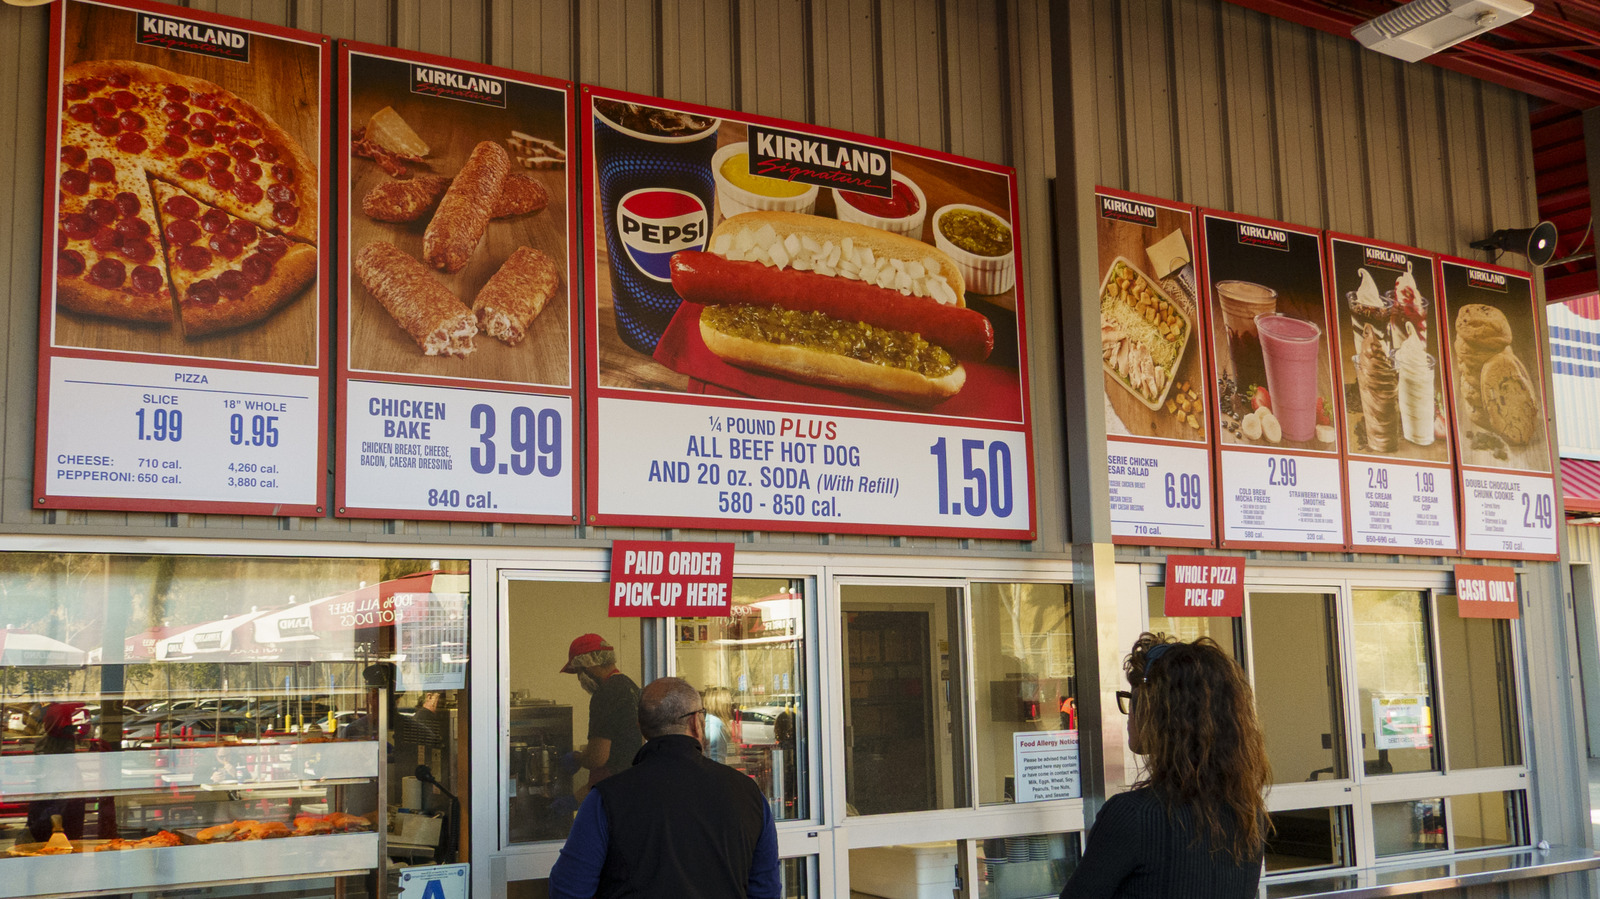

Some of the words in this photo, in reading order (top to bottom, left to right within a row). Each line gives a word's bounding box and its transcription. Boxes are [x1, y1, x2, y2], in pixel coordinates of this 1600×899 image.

[144, 17, 245, 48] KIRKLAND
[143, 34, 244, 57] Signature
[417, 68, 502, 95] KIRKLAND
[416, 83, 502, 103] Signature
[757, 132, 886, 176] KIRKLAND
[757, 159, 887, 189] Signature
[1104, 198, 1155, 218] KIRKLAND
[623, 214, 704, 244] PEPSI
[1240, 225, 1286, 242] KIRKLAND
[1366, 248, 1406, 264] KIRKLAND
[1469, 270, 1505, 285] KIRKLAND
[174, 373, 209, 384] PIZZA
[143, 394, 178, 405] SLICE
[245, 401, 287, 412] WHOLE
[369, 398, 445, 420] CHICKEN
[136, 408, 183, 442] 1.99
[230, 414, 279, 447] 9.95
[384, 420, 431, 440] BAKE
[727, 417, 775, 435] POUND
[780, 418, 837, 440] PLUS
[362, 442, 393, 454] CHICKEN
[395, 443, 423, 457] BREAST,
[424, 445, 451, 459] CHEESE,
[470, 404, 562, 477] 3.99
[687, 436, 722, 458] ALL
[730, 438, 774, 460] BEEF
[781, 442, 817, 464] HOT
[824, 445, 860, 467] DOG
[58, 455, 114, 466] CHEESE:
[138, 458, 158, 469] 710
[162, 458, 182, 469] cal.
[228, 463, 257, 474] 4,260
[260, 464, 279, 474] cal.
[361, 455, 387, 468] BACON,
[390, 457, 417, 468] CAESAR
[419, 458, 453, 470] DRESSING
[1128, 467, 1149, 476] SALAD
[1130, 457, 1158, 467] CHICKEN
[1268, 457, 1297, 486] 2.99
[57, 470, 135, 482] PEPPERONI:
[138, 473, 158, 483] 650
[162, 473, 182, 484] cal.
[228, 478, 257, 488] 3,880
[260, 479, 278, 488] cal.
[648, 461, 690, 483] AND
[698, 463, 720, 485] 20
[727, 469, 752, 486] oz.
[760, 466, 810, 490] SODA
[817, 474, 853, 494] (With
[858, 476, 899, 497] Refill)
[930, 436, 1013, 518] 1.50
[1368, 468, 1388, 489] 2.49
[1415, 472, 1434, 492] 1.99
[1465, 479, 1488, 488] DOUBLE
[1489, 481, 1520, 491] CHOCOLATE
[428, 489, 460, 507] 840
[466, 492, 498, 509] cal.
[1165, 472, 1201, 510] 6.99
[1422, 496, 1438, 504] CREAM
[1474, 489, 1493, 499] CHUNK
[1494, 491, 1514, 500] COOKIE
[718, 492, 752, 513] 580
[773, 494, 805, 515] 850
[812, 497, 841, 517] cal.
[1369, 501, 1389, 509] SUNDAE
[1522, 493, 1552, 529] 2.49
[1134, 525, 1147, 534] 710
[1149, 526, 1161, 535] cal.
[1502, 541, 1512, 550] 750
[1514, 542, 1524, 550] cal.
[625, 551, 664, 575] PAID
[668, 552, 722, 575] ORDER
[1175, 566, 1208, 584] WHOLE
[1210, 567, 1236, 584] PIZZA
[615, 582, 682, 606] PICK-UP
[687, 583, 727, 606] HERE
[1185, 589, 1224, 606] PICK-UP
[1458, 579, 1487, 601] CASH
[1489, 580, 1514, 602] ONLY
